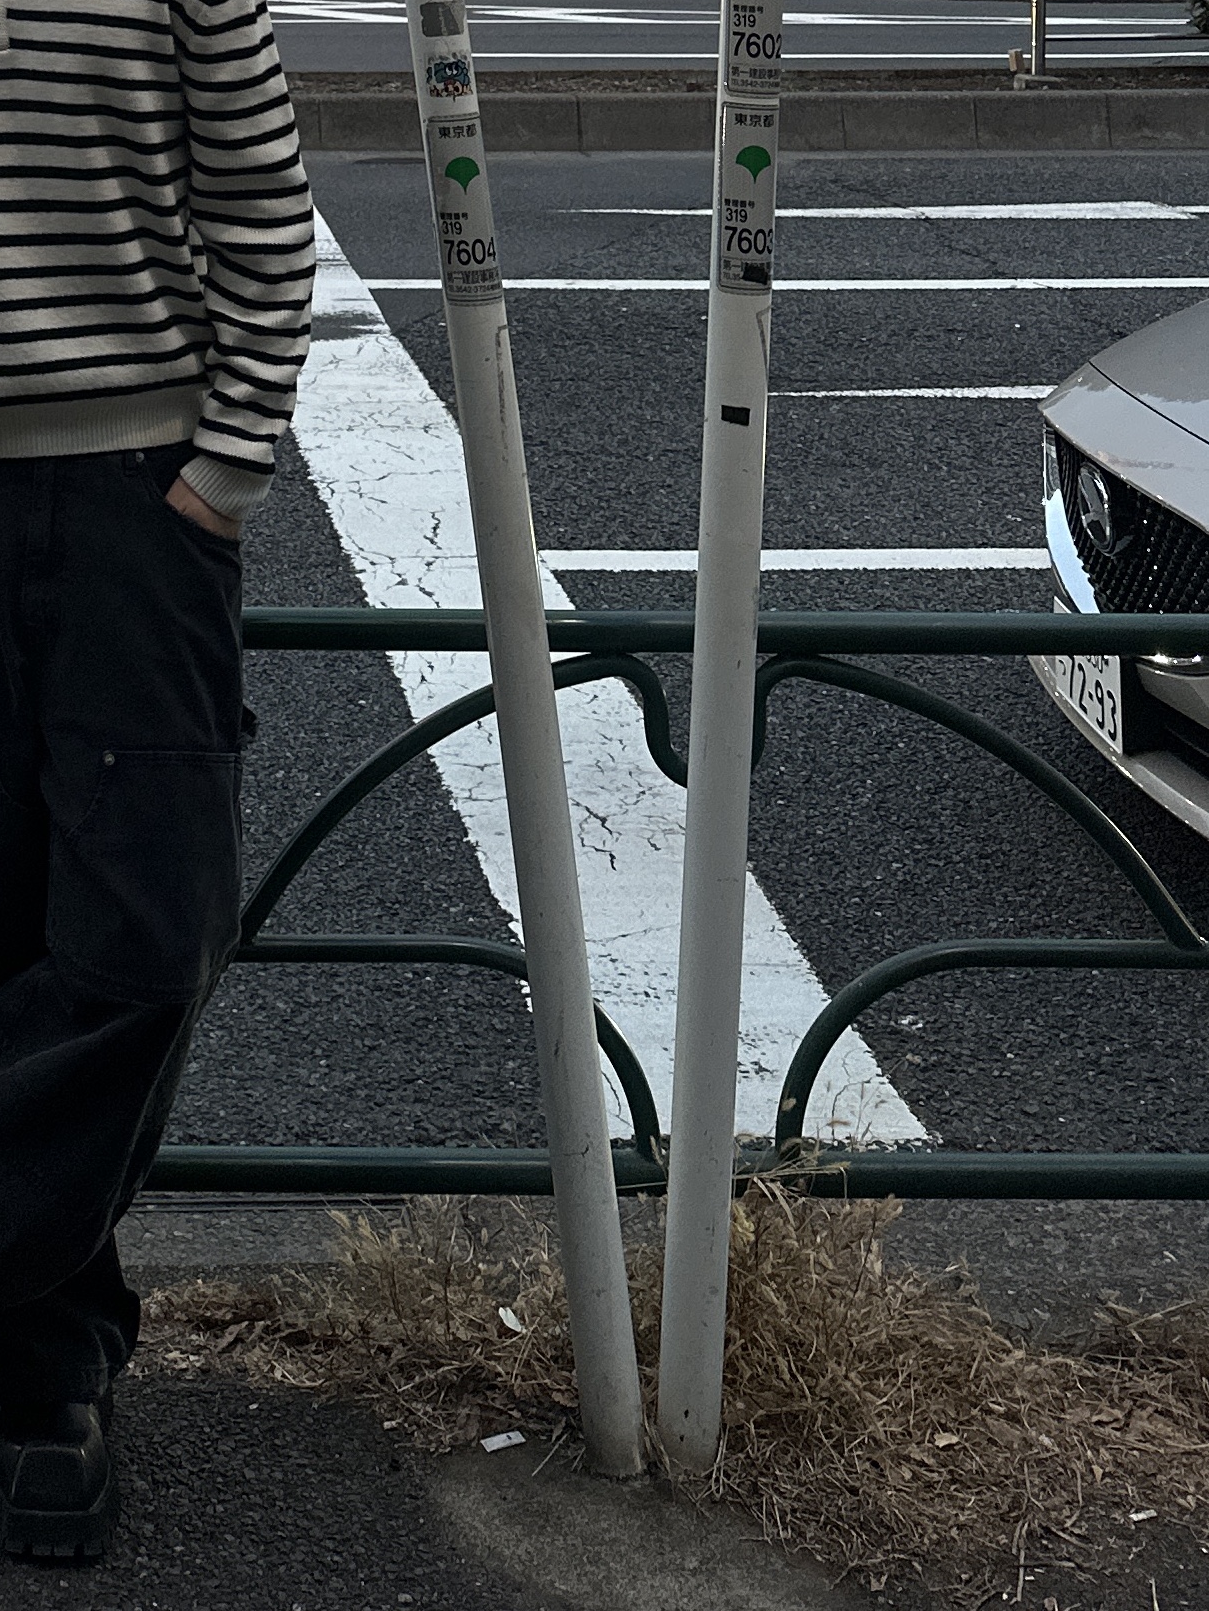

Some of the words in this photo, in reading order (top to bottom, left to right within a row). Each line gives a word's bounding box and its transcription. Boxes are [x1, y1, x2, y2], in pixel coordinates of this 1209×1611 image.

[733, 13, 756, 27] 319
[732, 31, 782, 59] 7602
[734, 113, 775, 128] 東京都
[437, 123, 478, 139] 東京都
[725, 208, 748, 223] 319
[442, 220, 462, 235] 319
[443, 237, 497, 266] 7604
